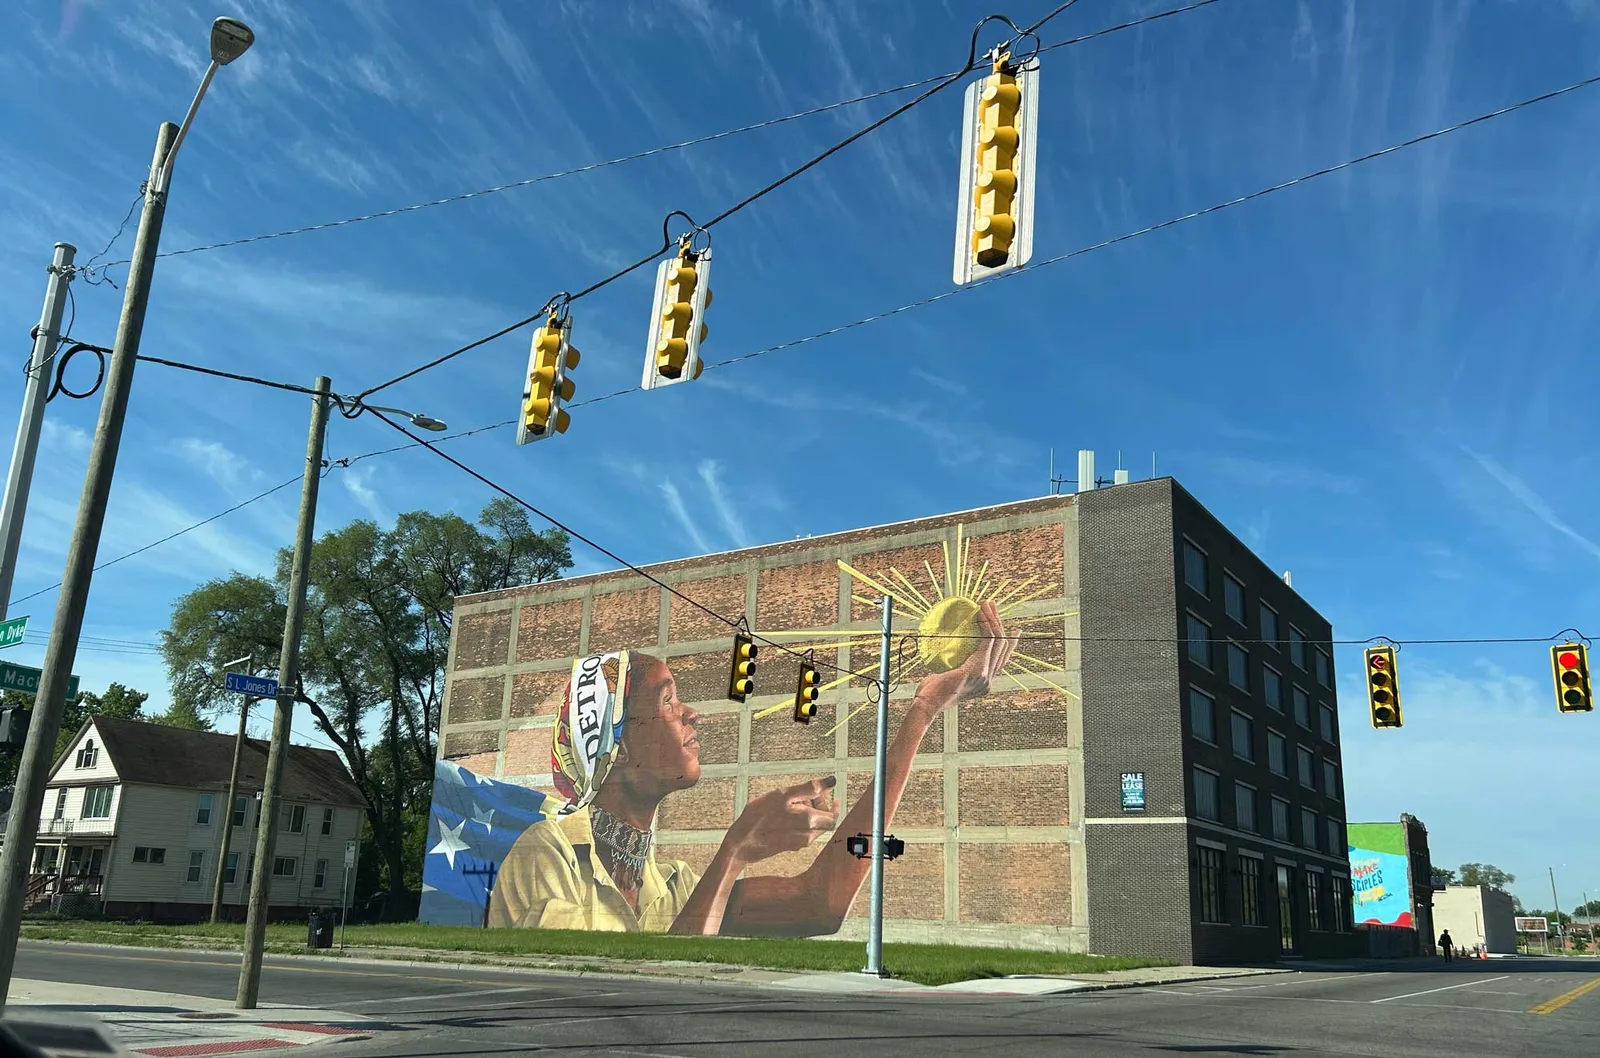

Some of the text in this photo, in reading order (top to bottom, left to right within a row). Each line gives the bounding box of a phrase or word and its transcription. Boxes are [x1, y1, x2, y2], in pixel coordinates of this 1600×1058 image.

[6, 624, 25, 642] Dyke
[227, 676, 277, 695] S L Jones Dr
[577, 654, 603, 764] DETRO
[1121, 773, 1143, 782] SALE
[1122, 782, 1143, 790] LEASE
[1351, 869, 1383, 892] SCIPLES
